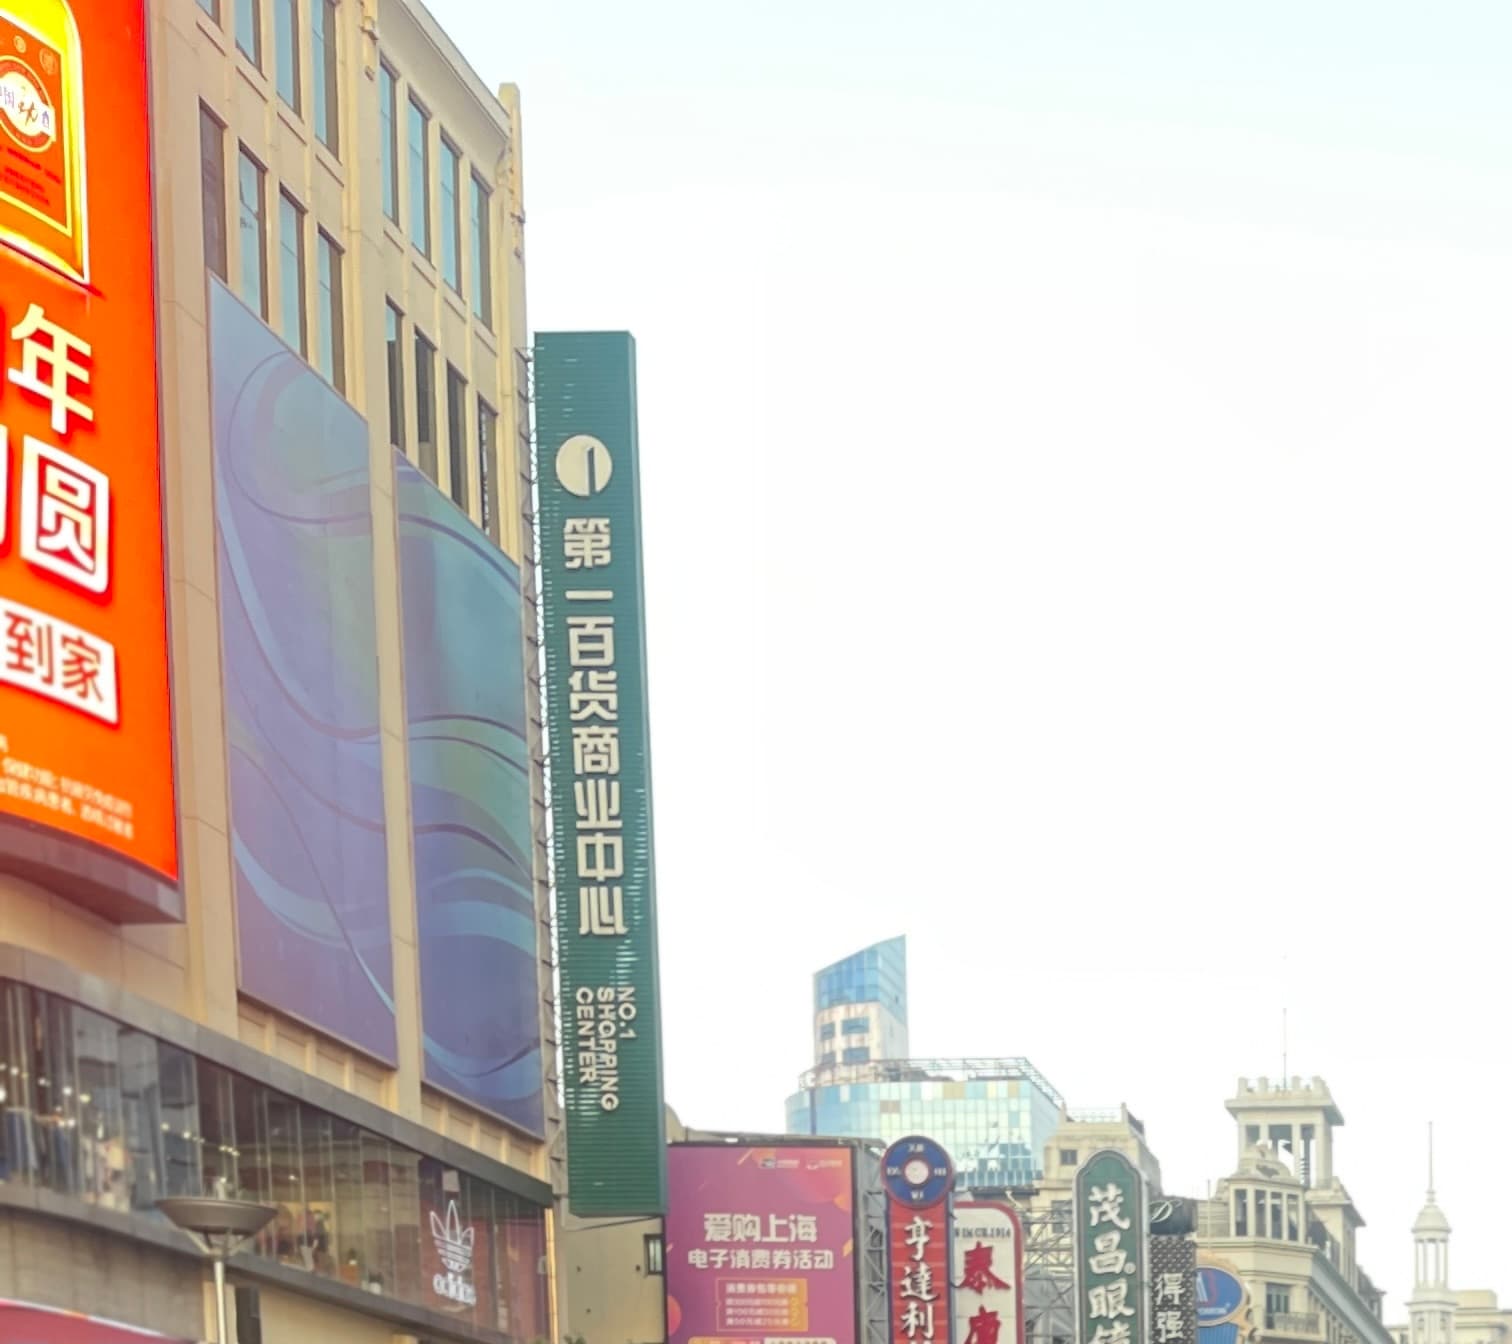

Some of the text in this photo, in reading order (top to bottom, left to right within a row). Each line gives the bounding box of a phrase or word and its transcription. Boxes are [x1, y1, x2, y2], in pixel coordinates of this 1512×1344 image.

[7, 302, 94, 435] 年
[0, 424, 109, 594] 圆
[4, 610, 103, 702] 到家
[562, 517, 629, 936] 第一百货商业中心
[575, 986, 598, 1084] CENTER
[596, 985, 620, 1112] SHOPPING
[617, 986, 637, 1040] NO.1
[687, 1248, 834, 1271] 电子消费券活动
[703, 1212, 819, 1243] 爱购上海
